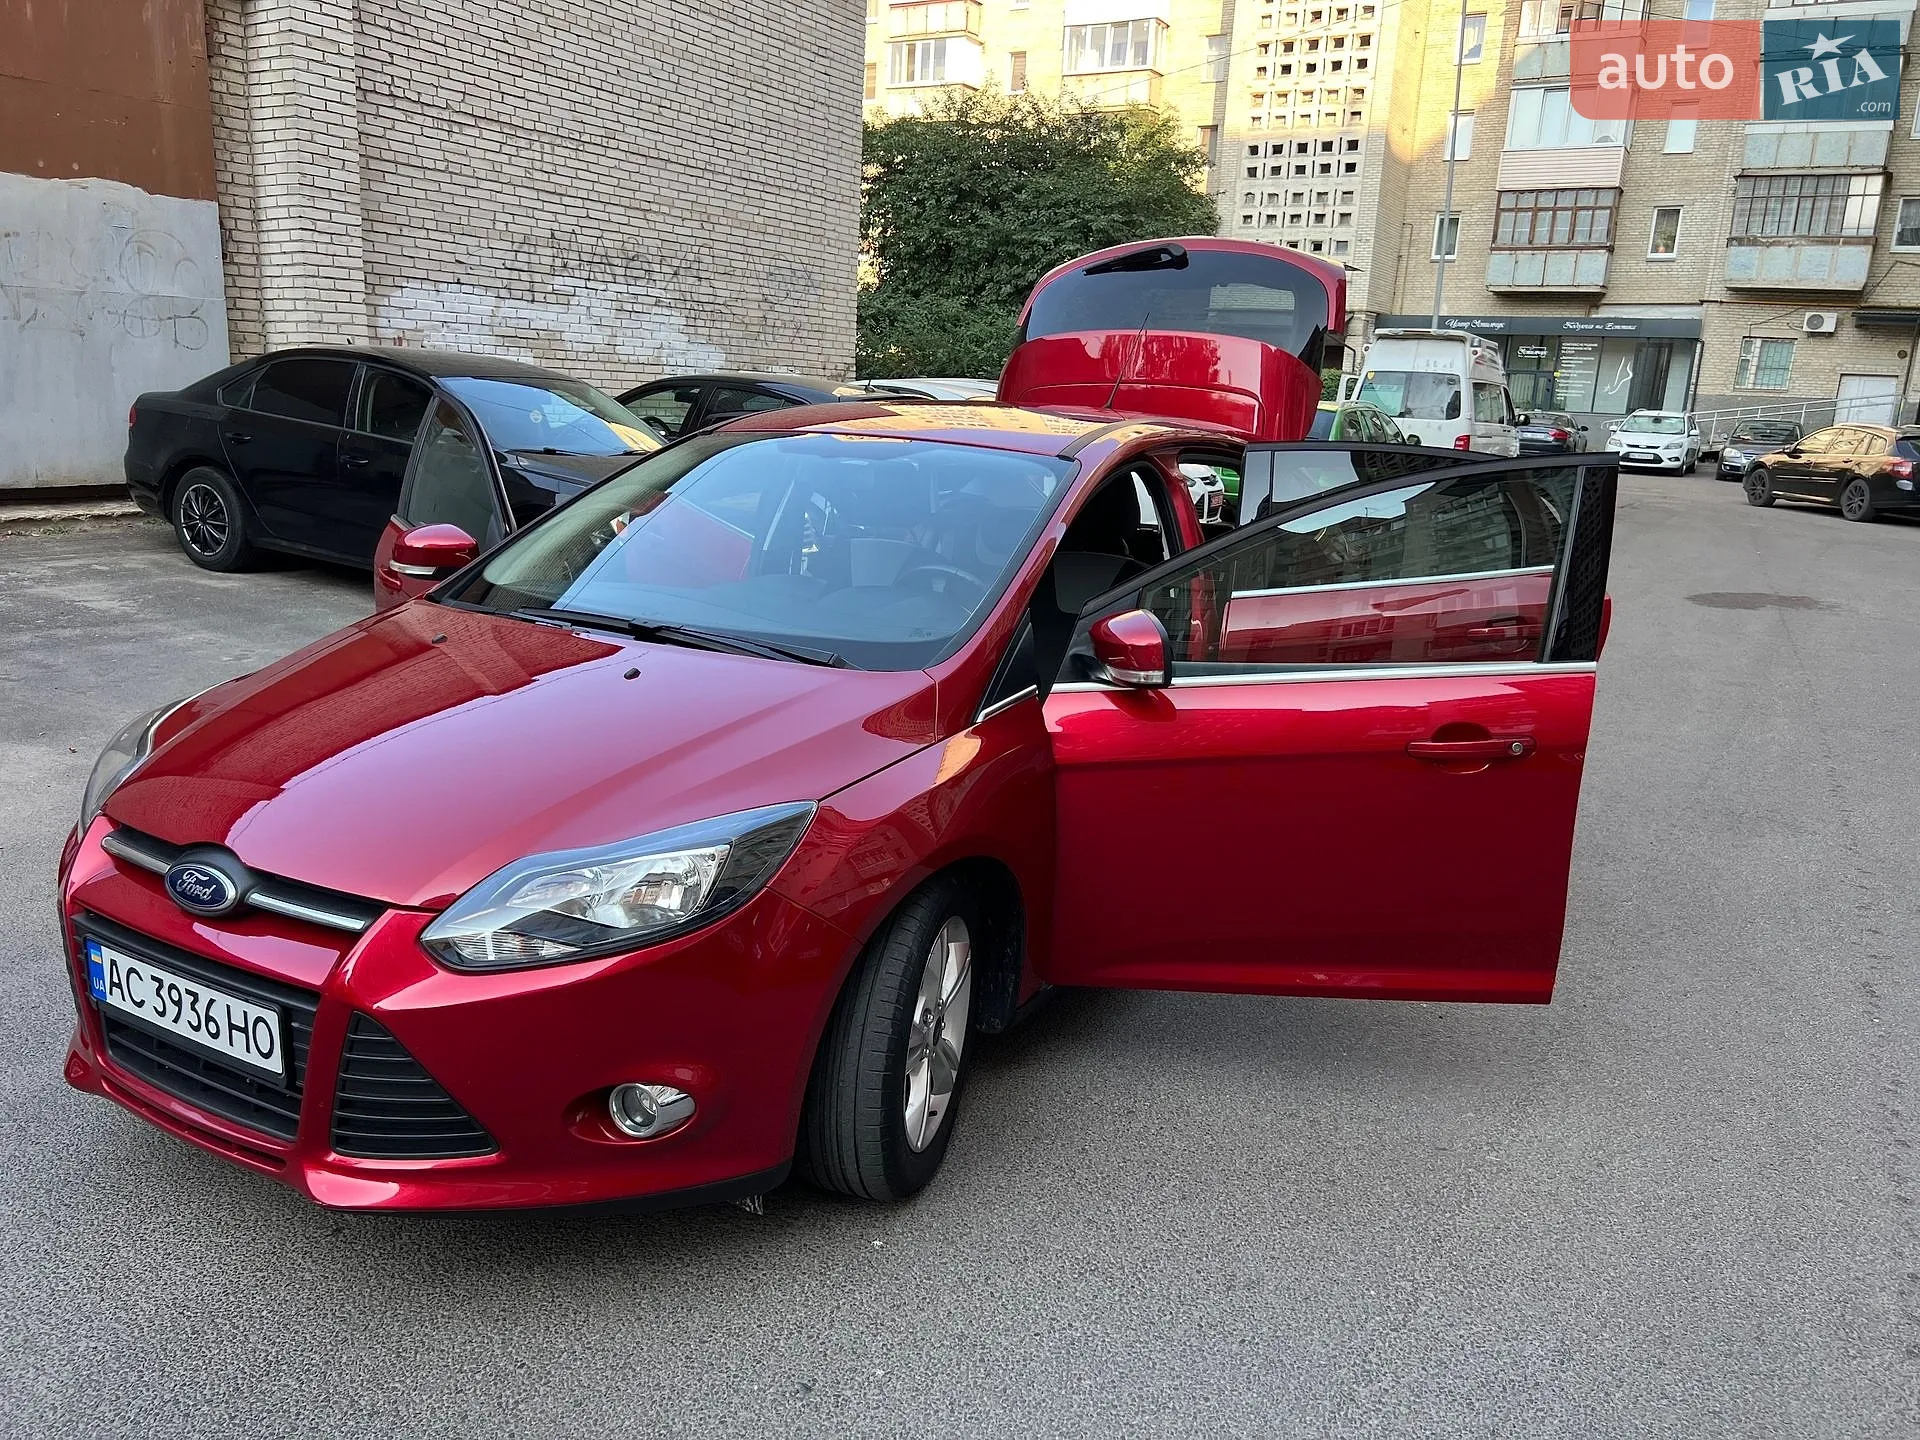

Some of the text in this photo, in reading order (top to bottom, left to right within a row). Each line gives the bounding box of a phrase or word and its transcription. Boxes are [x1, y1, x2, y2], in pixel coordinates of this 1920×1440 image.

[176, 869, 217, 902] Ford
[93, 978, 105, 993] UA
[108, 959, 275, 1060] AC 3936 HO
